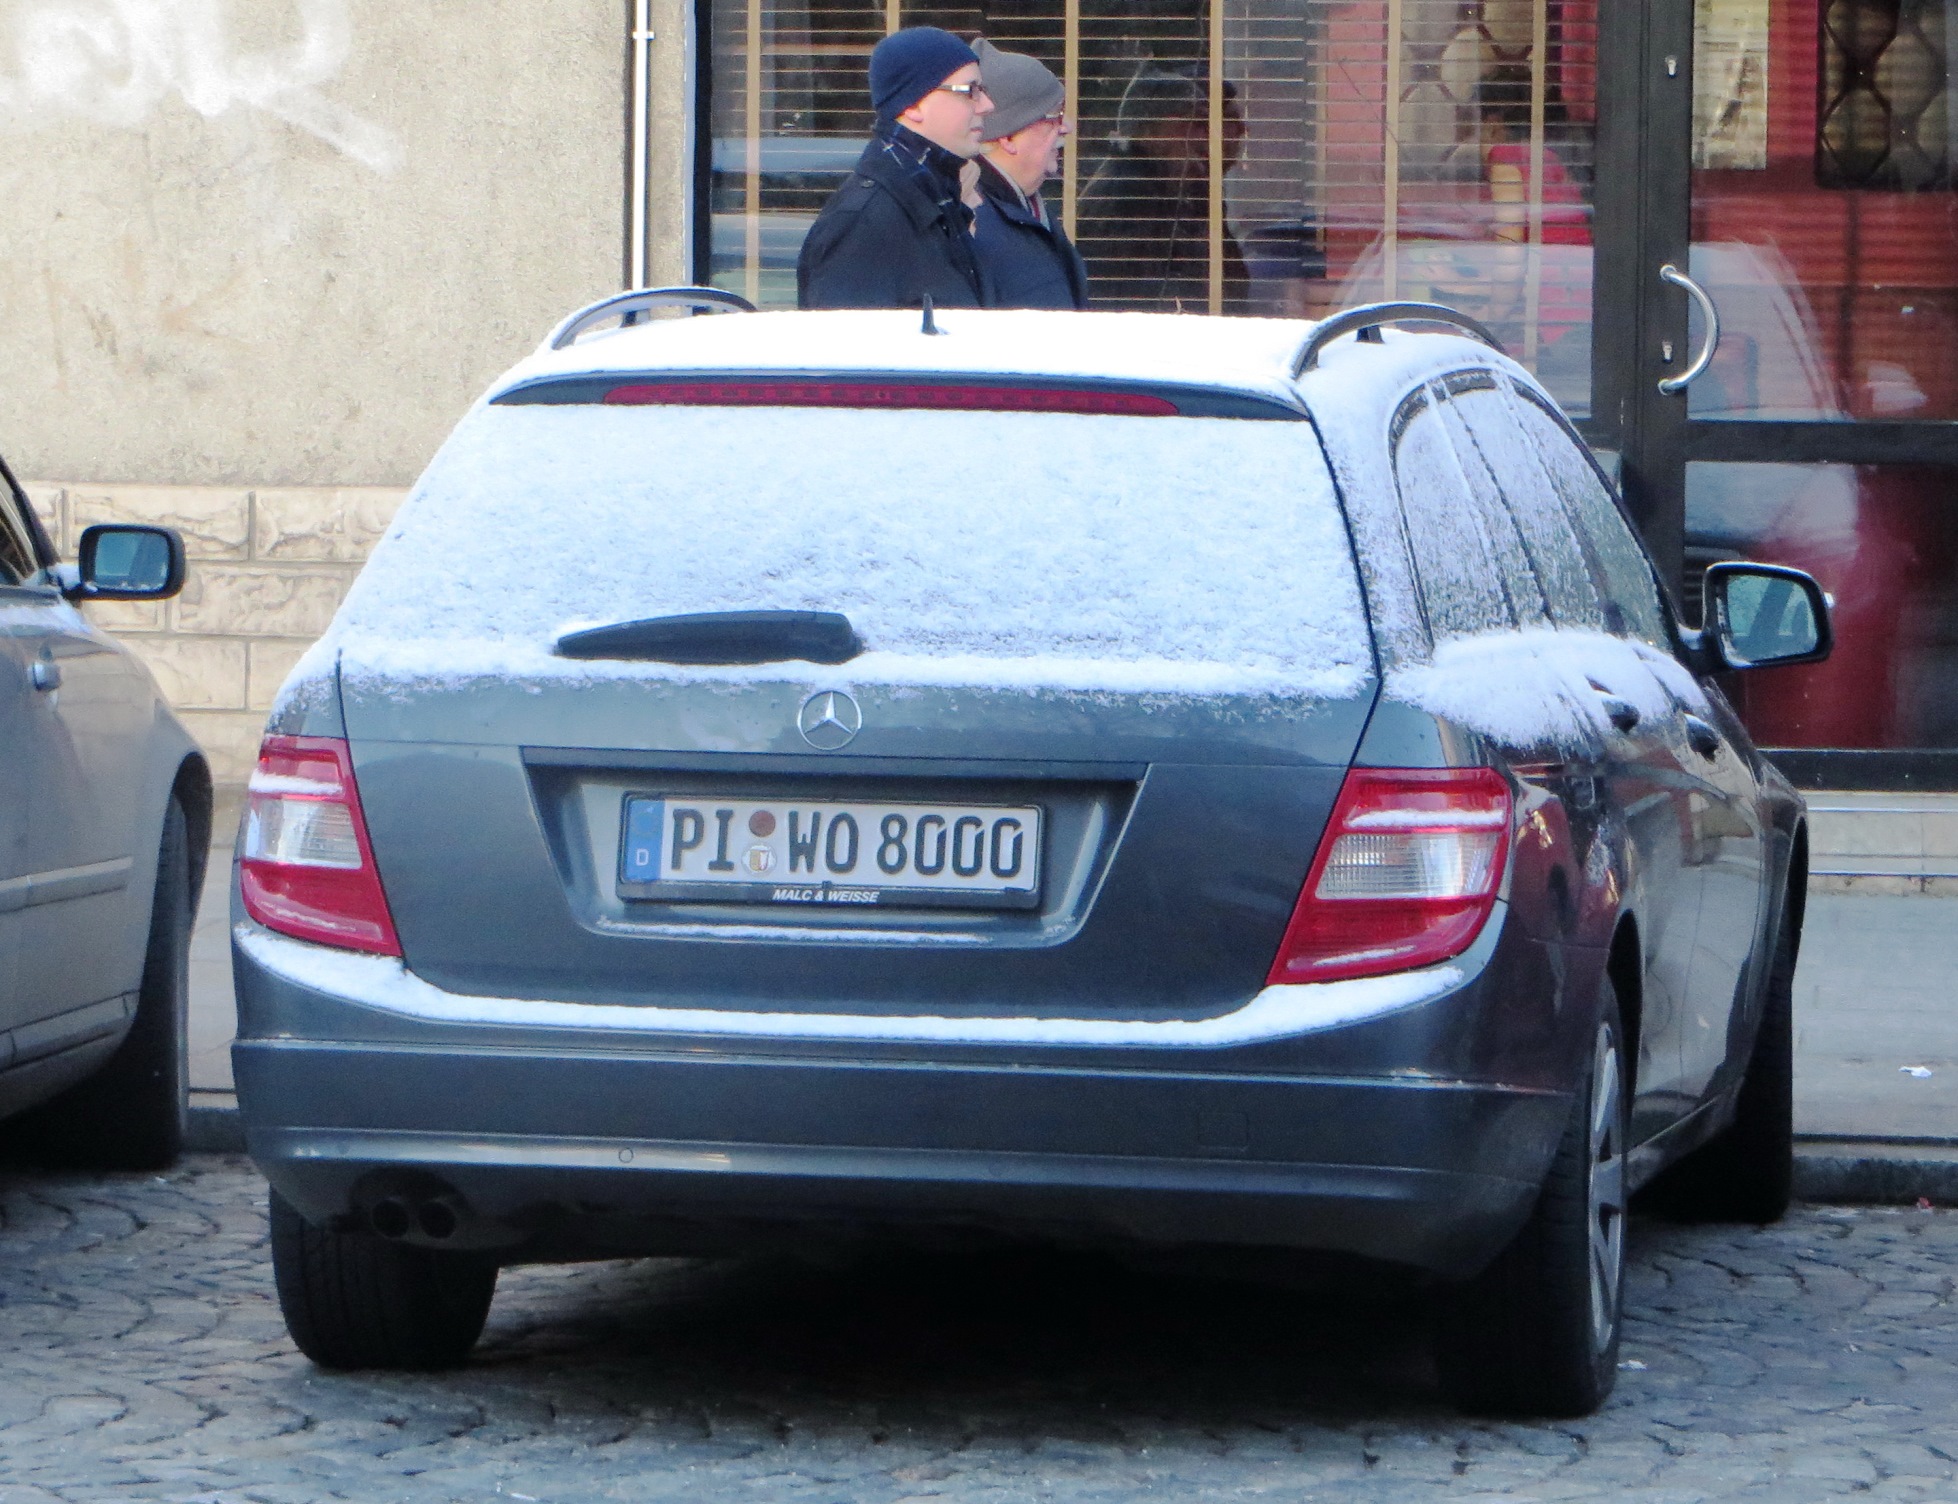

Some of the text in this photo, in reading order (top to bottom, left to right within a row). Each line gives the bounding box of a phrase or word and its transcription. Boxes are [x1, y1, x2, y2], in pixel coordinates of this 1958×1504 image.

[671, 809, 1023, 878] PI WO 8000
[635, 848, 650, 866] D
[773, 888, 880, 904] MALC & WEISSE
